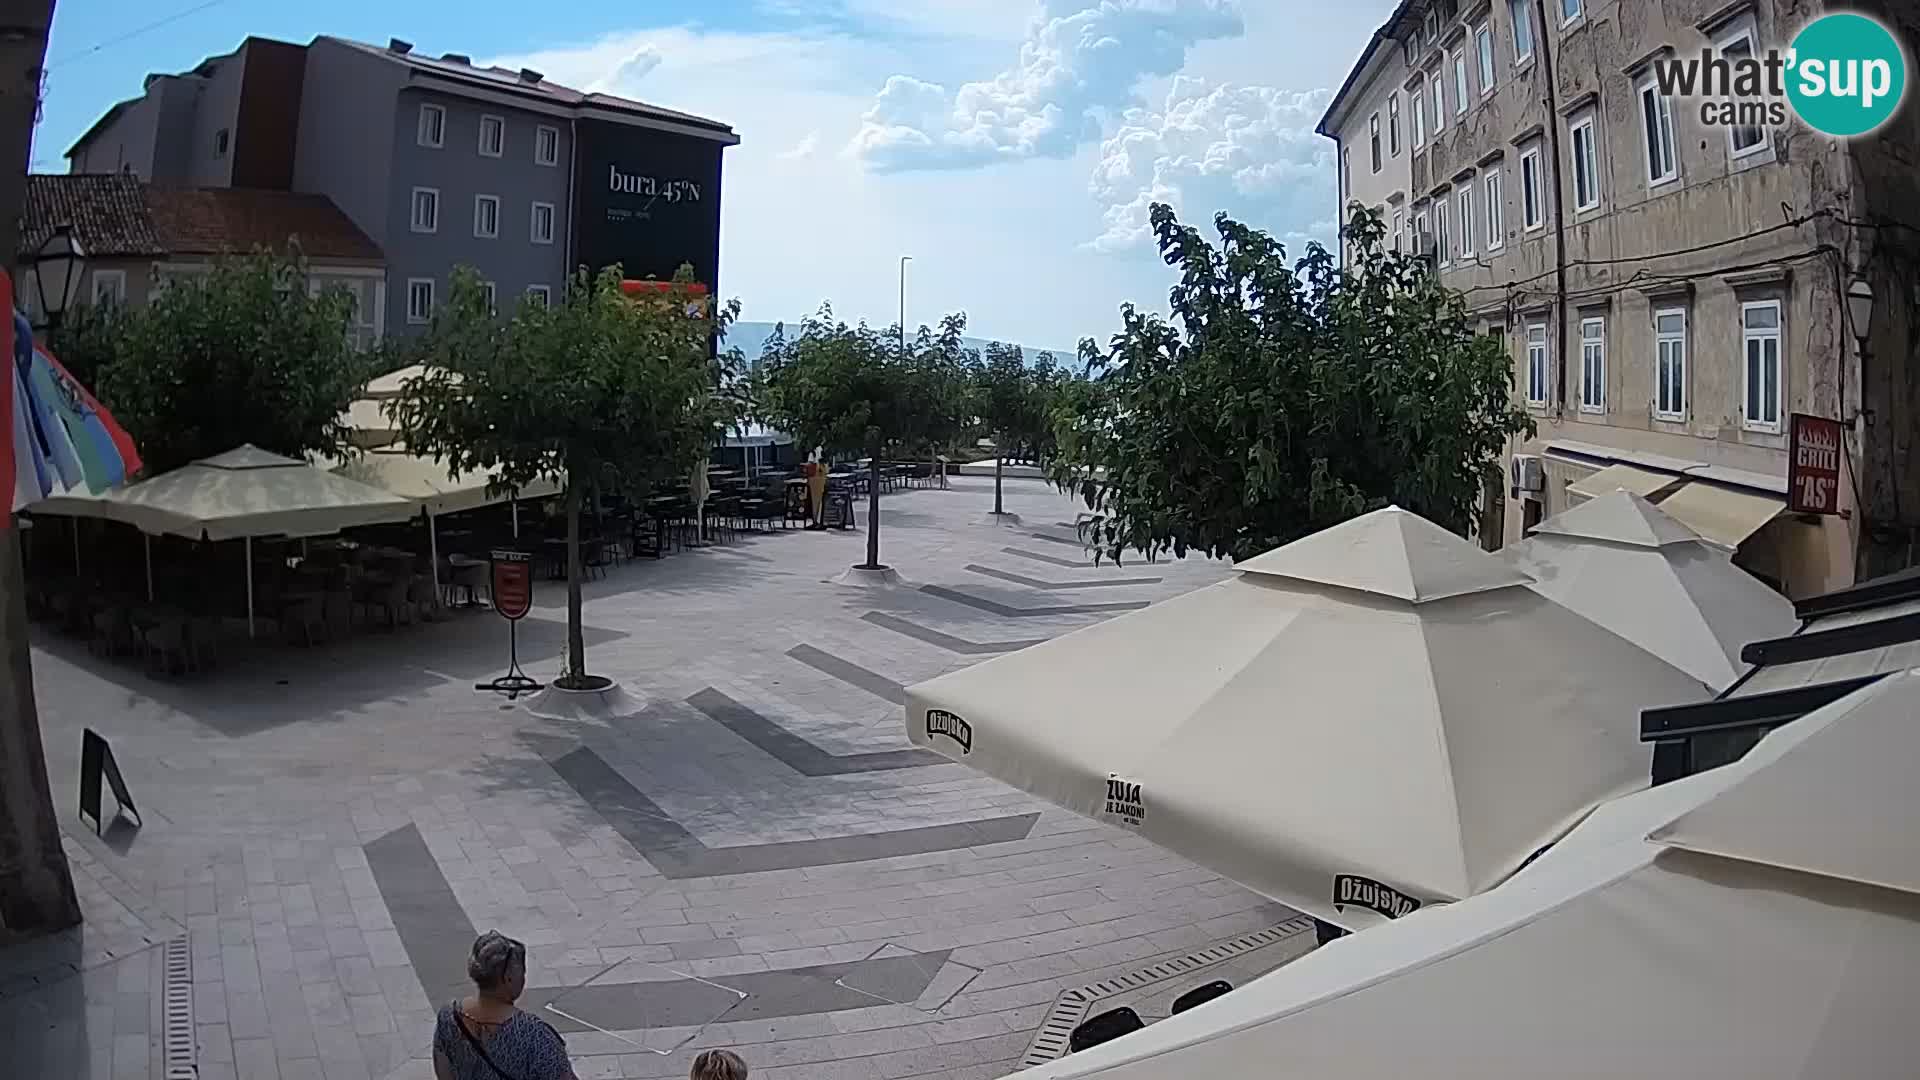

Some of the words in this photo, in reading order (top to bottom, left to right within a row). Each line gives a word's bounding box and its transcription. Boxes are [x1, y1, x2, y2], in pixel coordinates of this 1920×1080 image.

[610, 165, 656, 195] bura
[1797, 447, 1837, 471] GRILL
[930, 711, 968, 744] Ožujsko
[1105, 801, 1114, 813] JE
[1115, 802, 1145, 819] ZAKON!
[1341, 877, 1413, 918] Ožujsko
